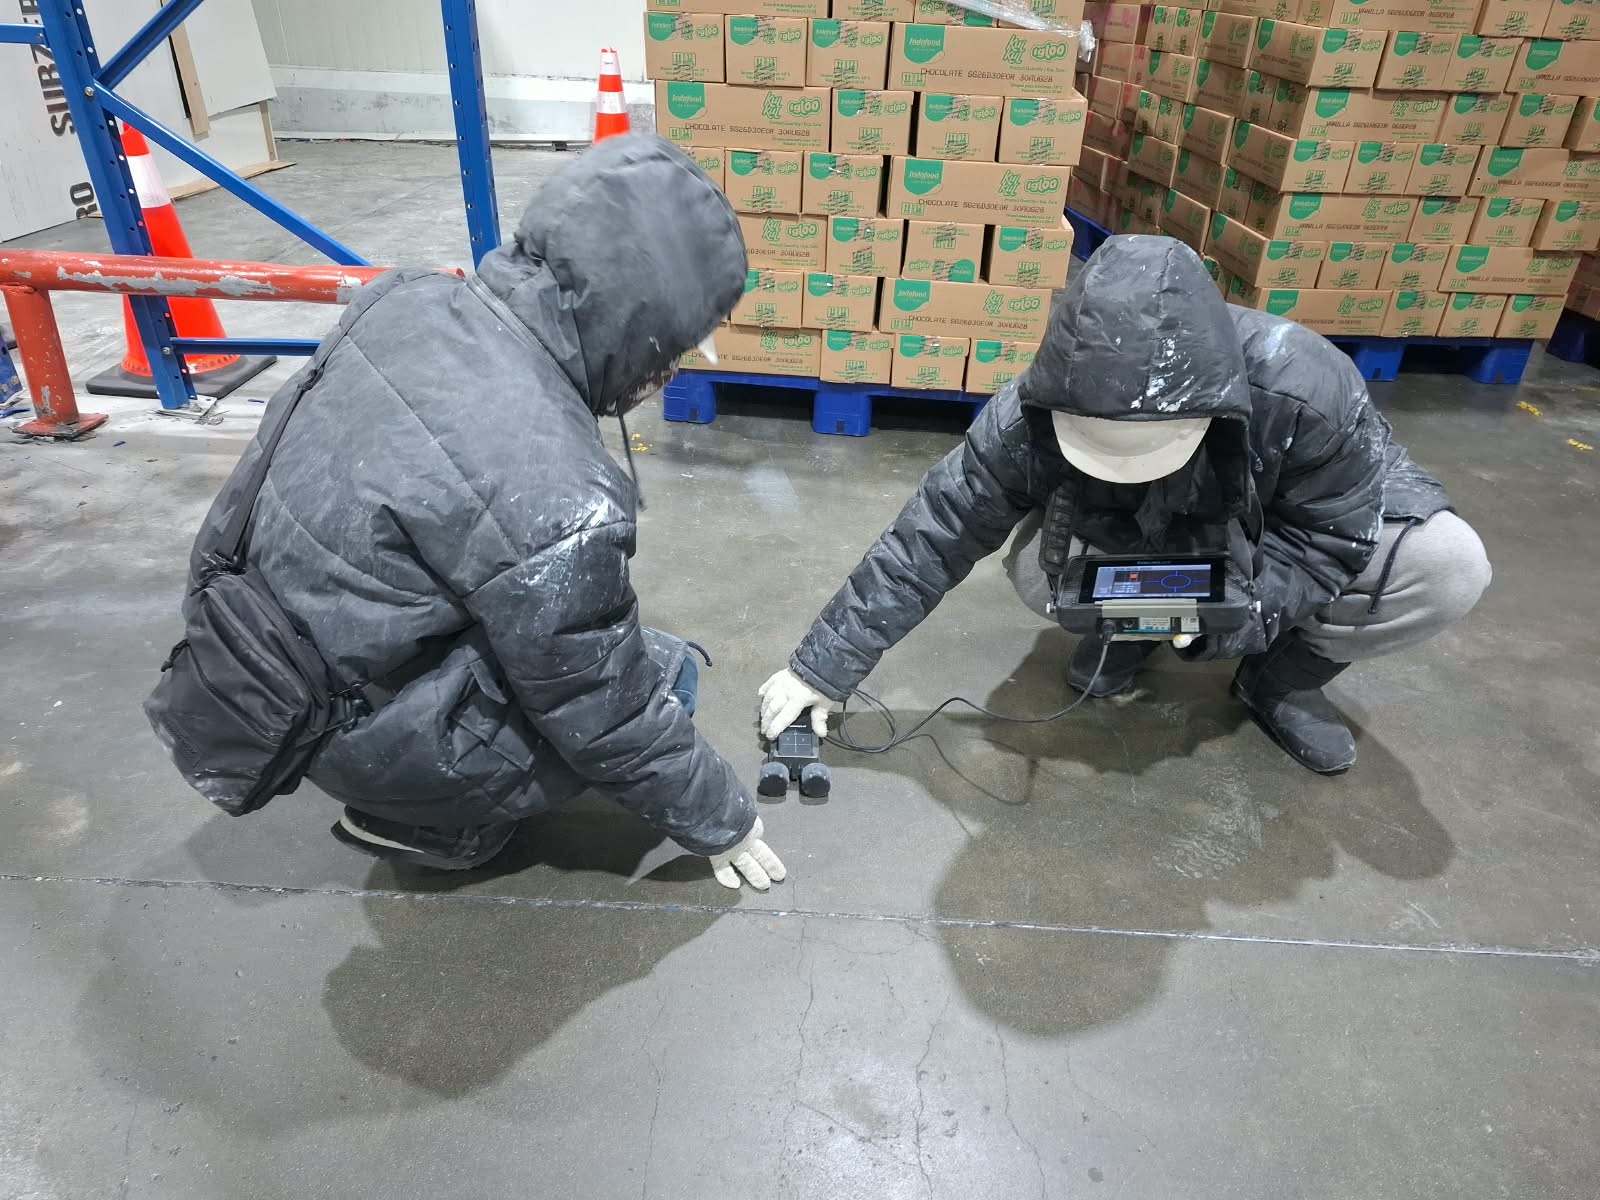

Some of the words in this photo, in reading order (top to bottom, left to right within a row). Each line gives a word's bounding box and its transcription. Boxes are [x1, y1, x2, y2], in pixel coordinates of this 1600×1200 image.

[1031, 40, 1068, 62] igloo
[18, 0, 76, 137] SUBZ
[921, 67, 963, 78] CHOCOLATE
[787, 96, 821, 117] igloo
[685, 123, 725, 132] CHOCOLATE
[1024, 175, 1060, 195] igloo
[918, 198, 959, 208] CHOCOLATE
[786, 223, 819, 239] igloo
[1008, 295, 1041, 313] igloo
[909, 315, 947, 324] CHOCOLATE
[783, 333, 812, 349] igloo
